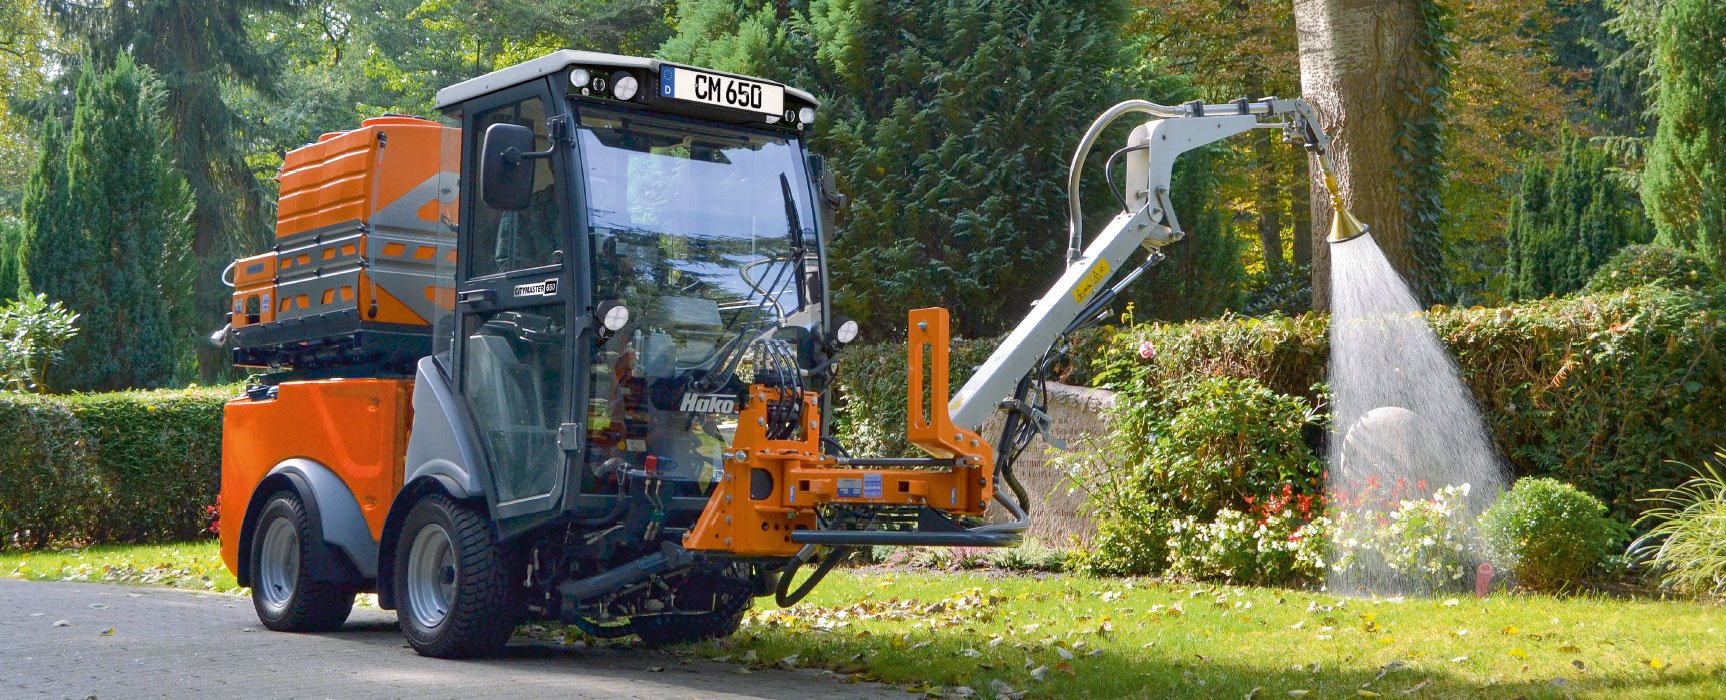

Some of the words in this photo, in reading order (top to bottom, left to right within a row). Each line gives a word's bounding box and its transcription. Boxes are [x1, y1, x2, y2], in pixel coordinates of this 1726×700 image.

[664, 85, 671, 95] D
[695, 74, 721, 102] CM
[726, 80, 762, 109] 650
[515, 284, 545, 295] CITYMASTER
[545, 283, 556, 292] 650
[680, 392, 735, 413] Hako
